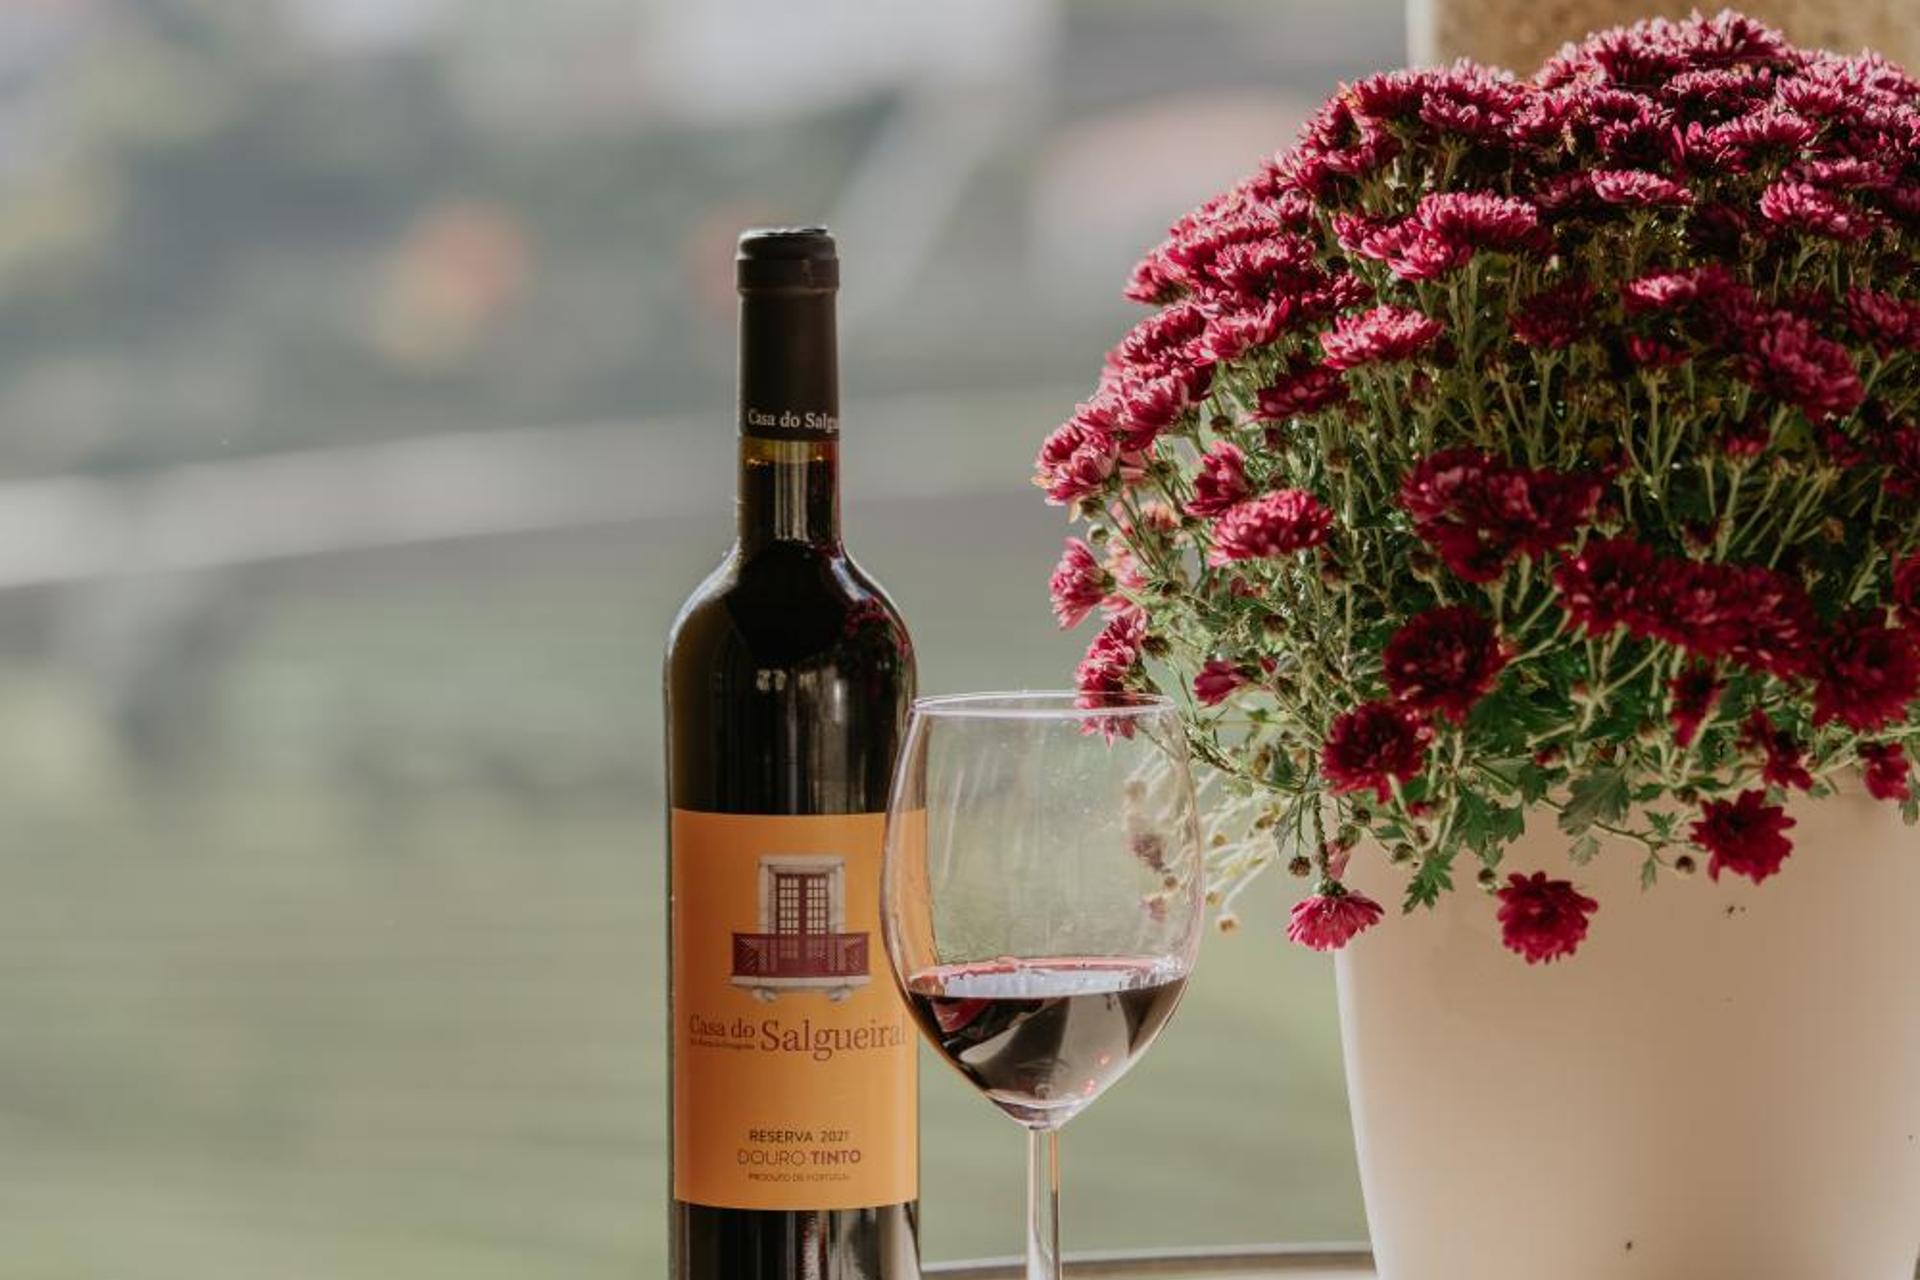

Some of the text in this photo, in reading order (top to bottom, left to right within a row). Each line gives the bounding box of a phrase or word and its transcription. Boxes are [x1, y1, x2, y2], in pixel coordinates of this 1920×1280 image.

[747, 407, 776, 427] Casa
[779, 410, 801, 428] do
[688, 1014, 726, 1037] Casa
[731, 1018, 756, 1039] do
[760, 1017, 907, 1062] Salgueiral
[748, 1130, 849, 1143] RESERVA 2021
[737, 1149, 862, 1166] DOURO TINTO
